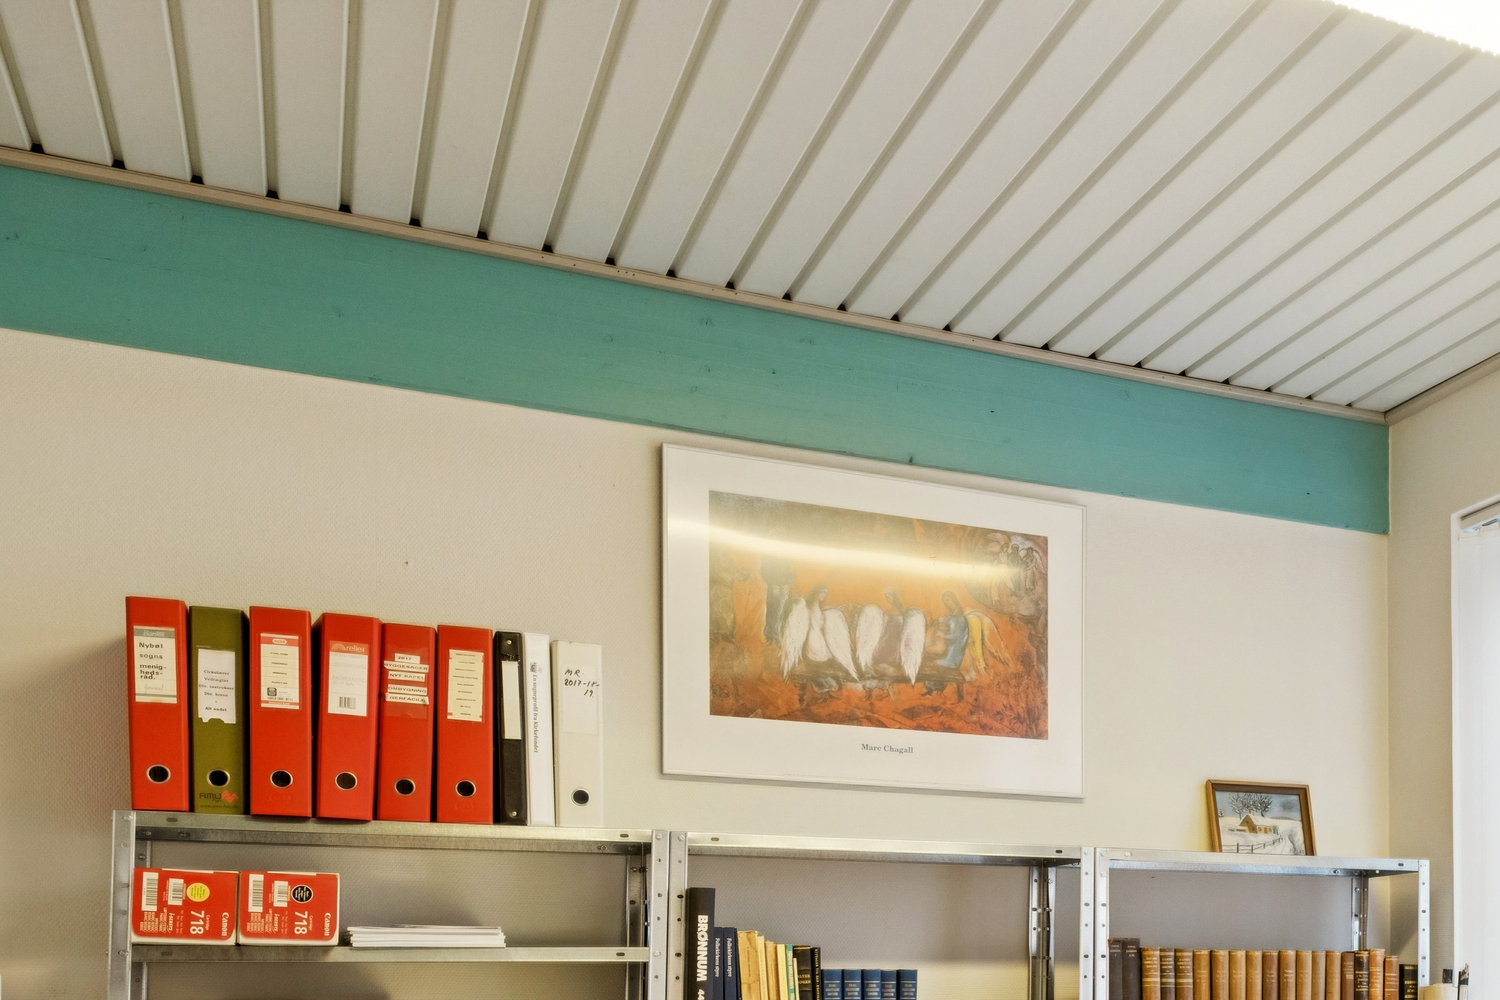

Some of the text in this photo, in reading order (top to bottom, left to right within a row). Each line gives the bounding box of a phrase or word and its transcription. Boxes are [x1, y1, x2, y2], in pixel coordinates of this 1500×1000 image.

[861, 743, 914, 755] Marc Chagall
[190, 910, 205, 934] 718
[221, 912, 230, 937] Canon
[294, 911, 308, 934] 718
[324, 912, 332, 936] Canon
[696, 914, 709, 982] BRØNNUM
[697, 989, 705, 1000] 44
